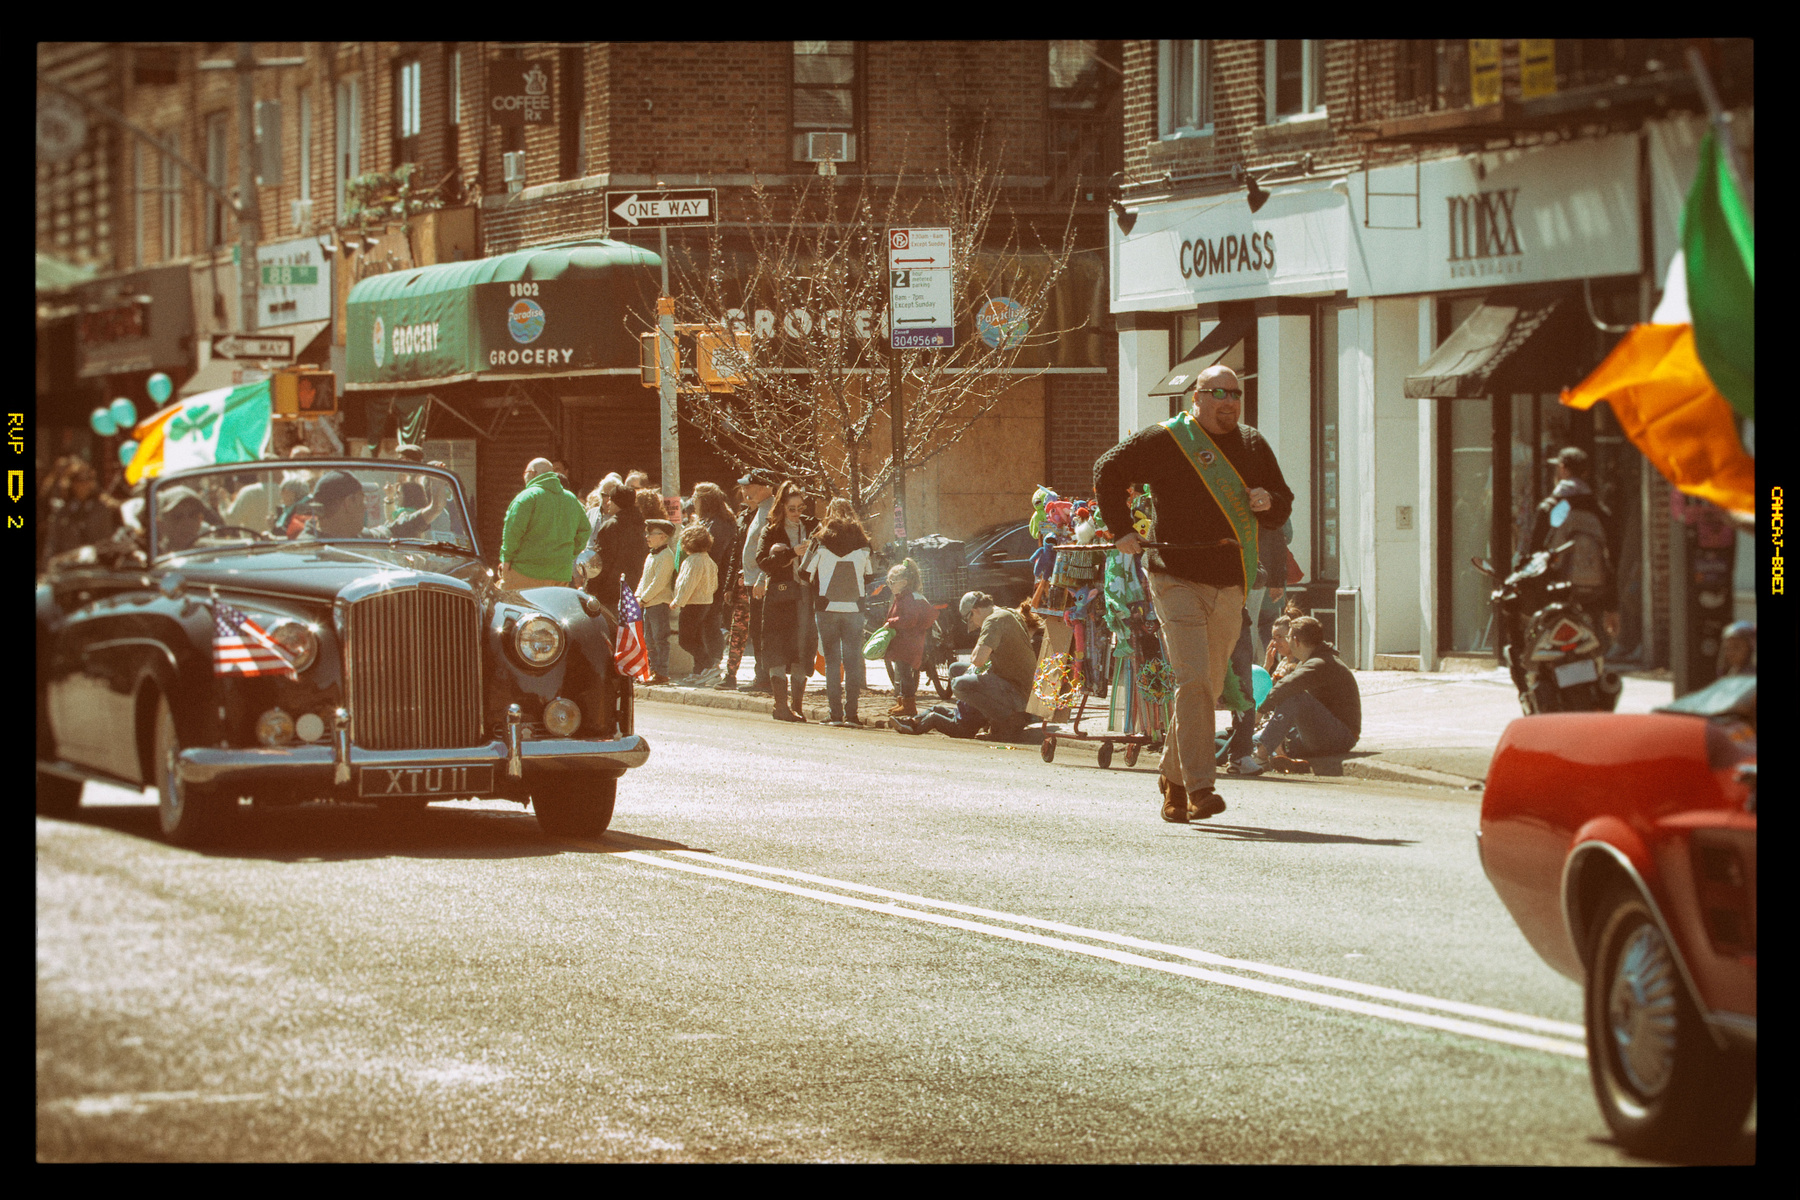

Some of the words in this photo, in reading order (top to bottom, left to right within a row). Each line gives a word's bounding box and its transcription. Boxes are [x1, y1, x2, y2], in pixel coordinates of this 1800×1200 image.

[490, 95, 551, 111] COFFEE
[524, 108, 542, 121] Rx
[627, 203, 659, 217] ONE
[668, 201, 701, 215] WAY
[269, 266, 292, 284] 88
[895, 271, 906, 287] 2
[509, 283, 540, 297] 8802
[508, 309, 544, 321] Paradise
[391, 321, 439, 355] GROCERY
[894, 335, 931, 346] 304956
[259, 340, 284, 353] WAY
[489, 348, 574, 365] GROCERY
[1215, 477, 1253, 543] COMMITTEE
[387, 768, 443, 793] XTU
